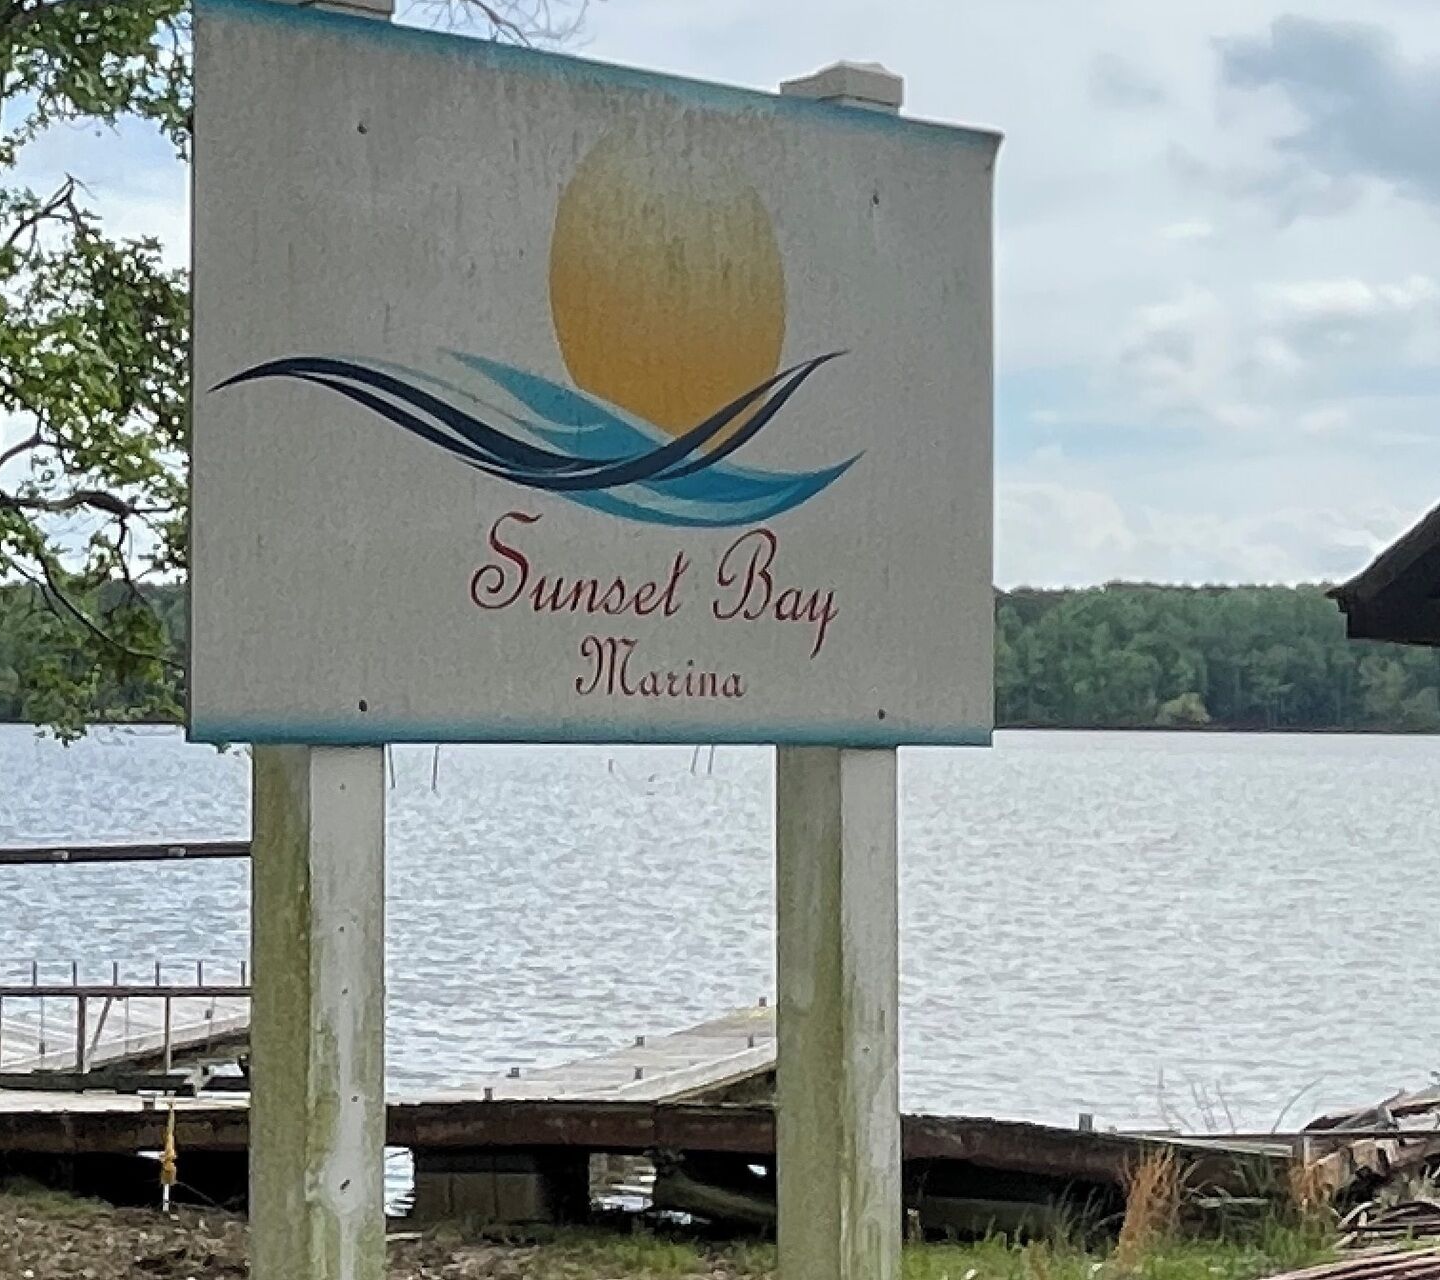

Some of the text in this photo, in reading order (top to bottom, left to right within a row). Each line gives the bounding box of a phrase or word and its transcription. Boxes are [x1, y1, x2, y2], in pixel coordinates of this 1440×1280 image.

[470, 511, 840, 660] Sunset Bay
[574, 634, 746, 698] Marina
